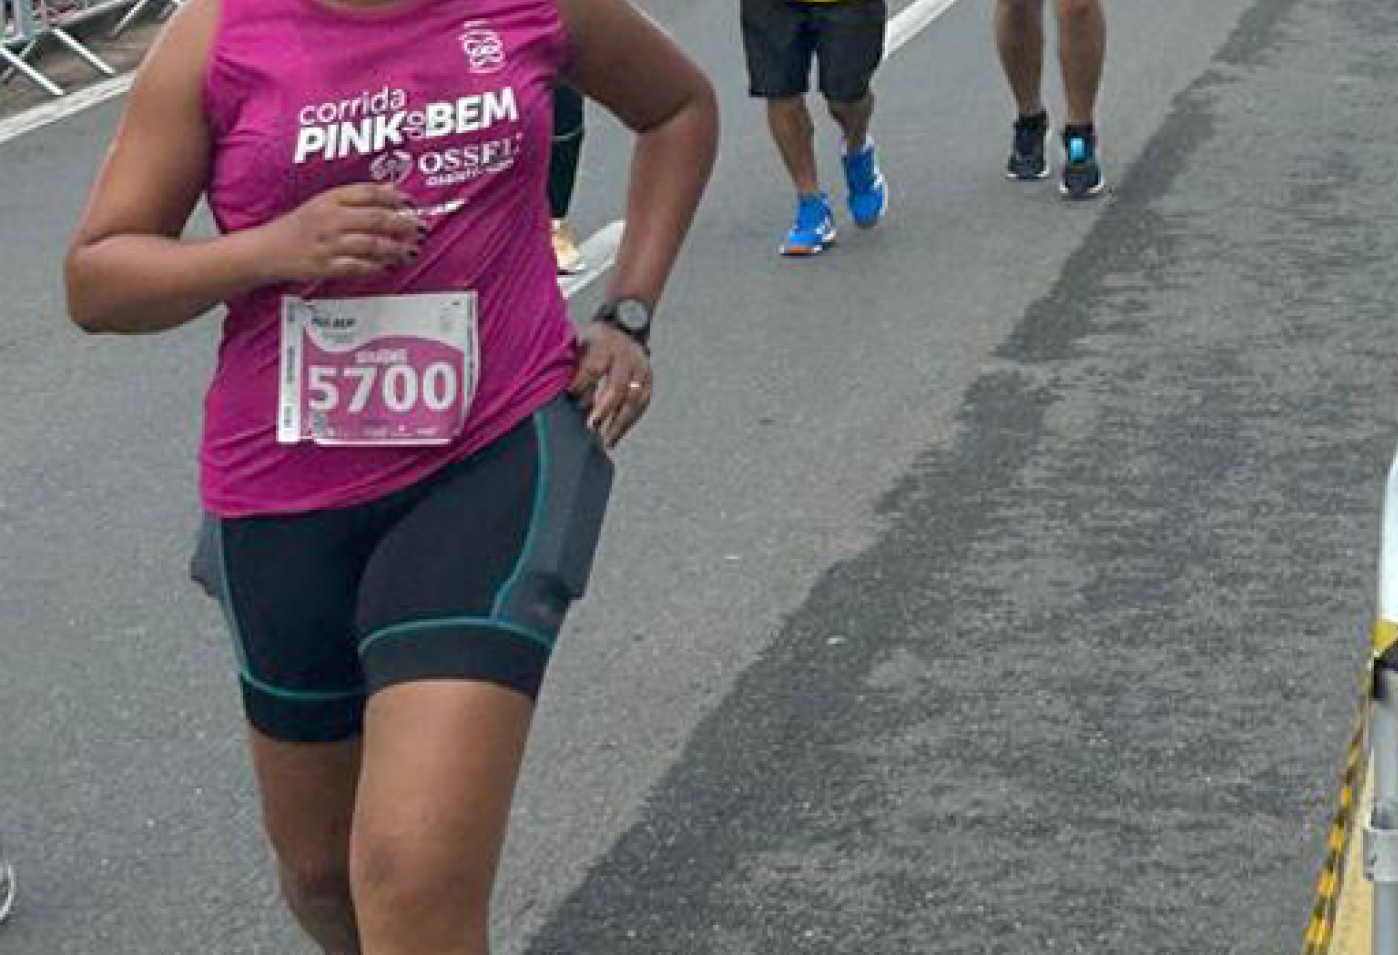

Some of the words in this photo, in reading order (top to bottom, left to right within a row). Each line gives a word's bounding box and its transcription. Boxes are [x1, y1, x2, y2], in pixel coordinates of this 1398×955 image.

[294, 110, 406, 164] PINK
[425, 85, 519, 137] BEM
[299, 85, 407, 126] corrida
[307, 362, 458, 415] 5700
